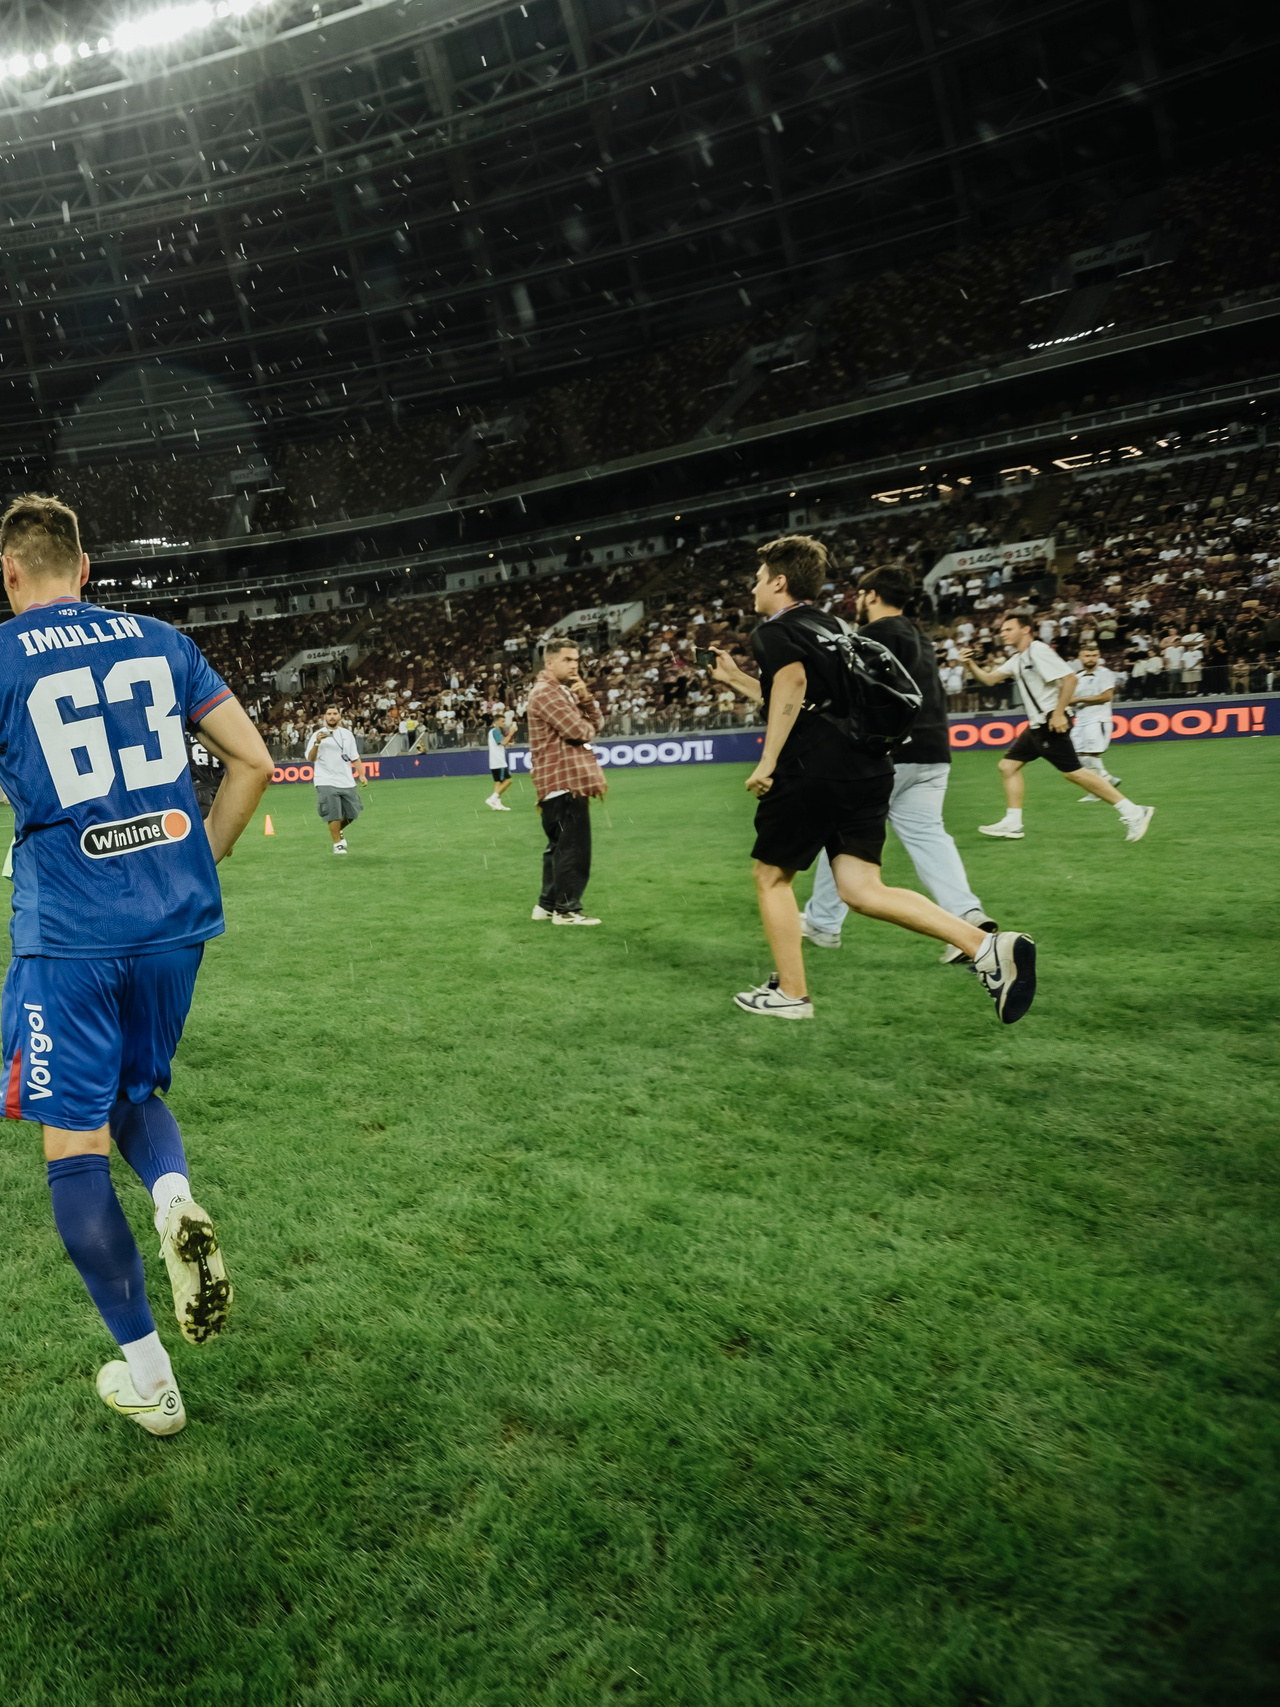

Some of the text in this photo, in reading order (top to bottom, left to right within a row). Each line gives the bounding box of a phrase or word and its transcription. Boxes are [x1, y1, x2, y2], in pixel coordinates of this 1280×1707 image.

[17, 617, 144, 657] IMULLIN
[26, 656, 189, 809] 63
[91, 823, 161, 851] Winline
[23, 1003, 53, 1101] Vorgol
